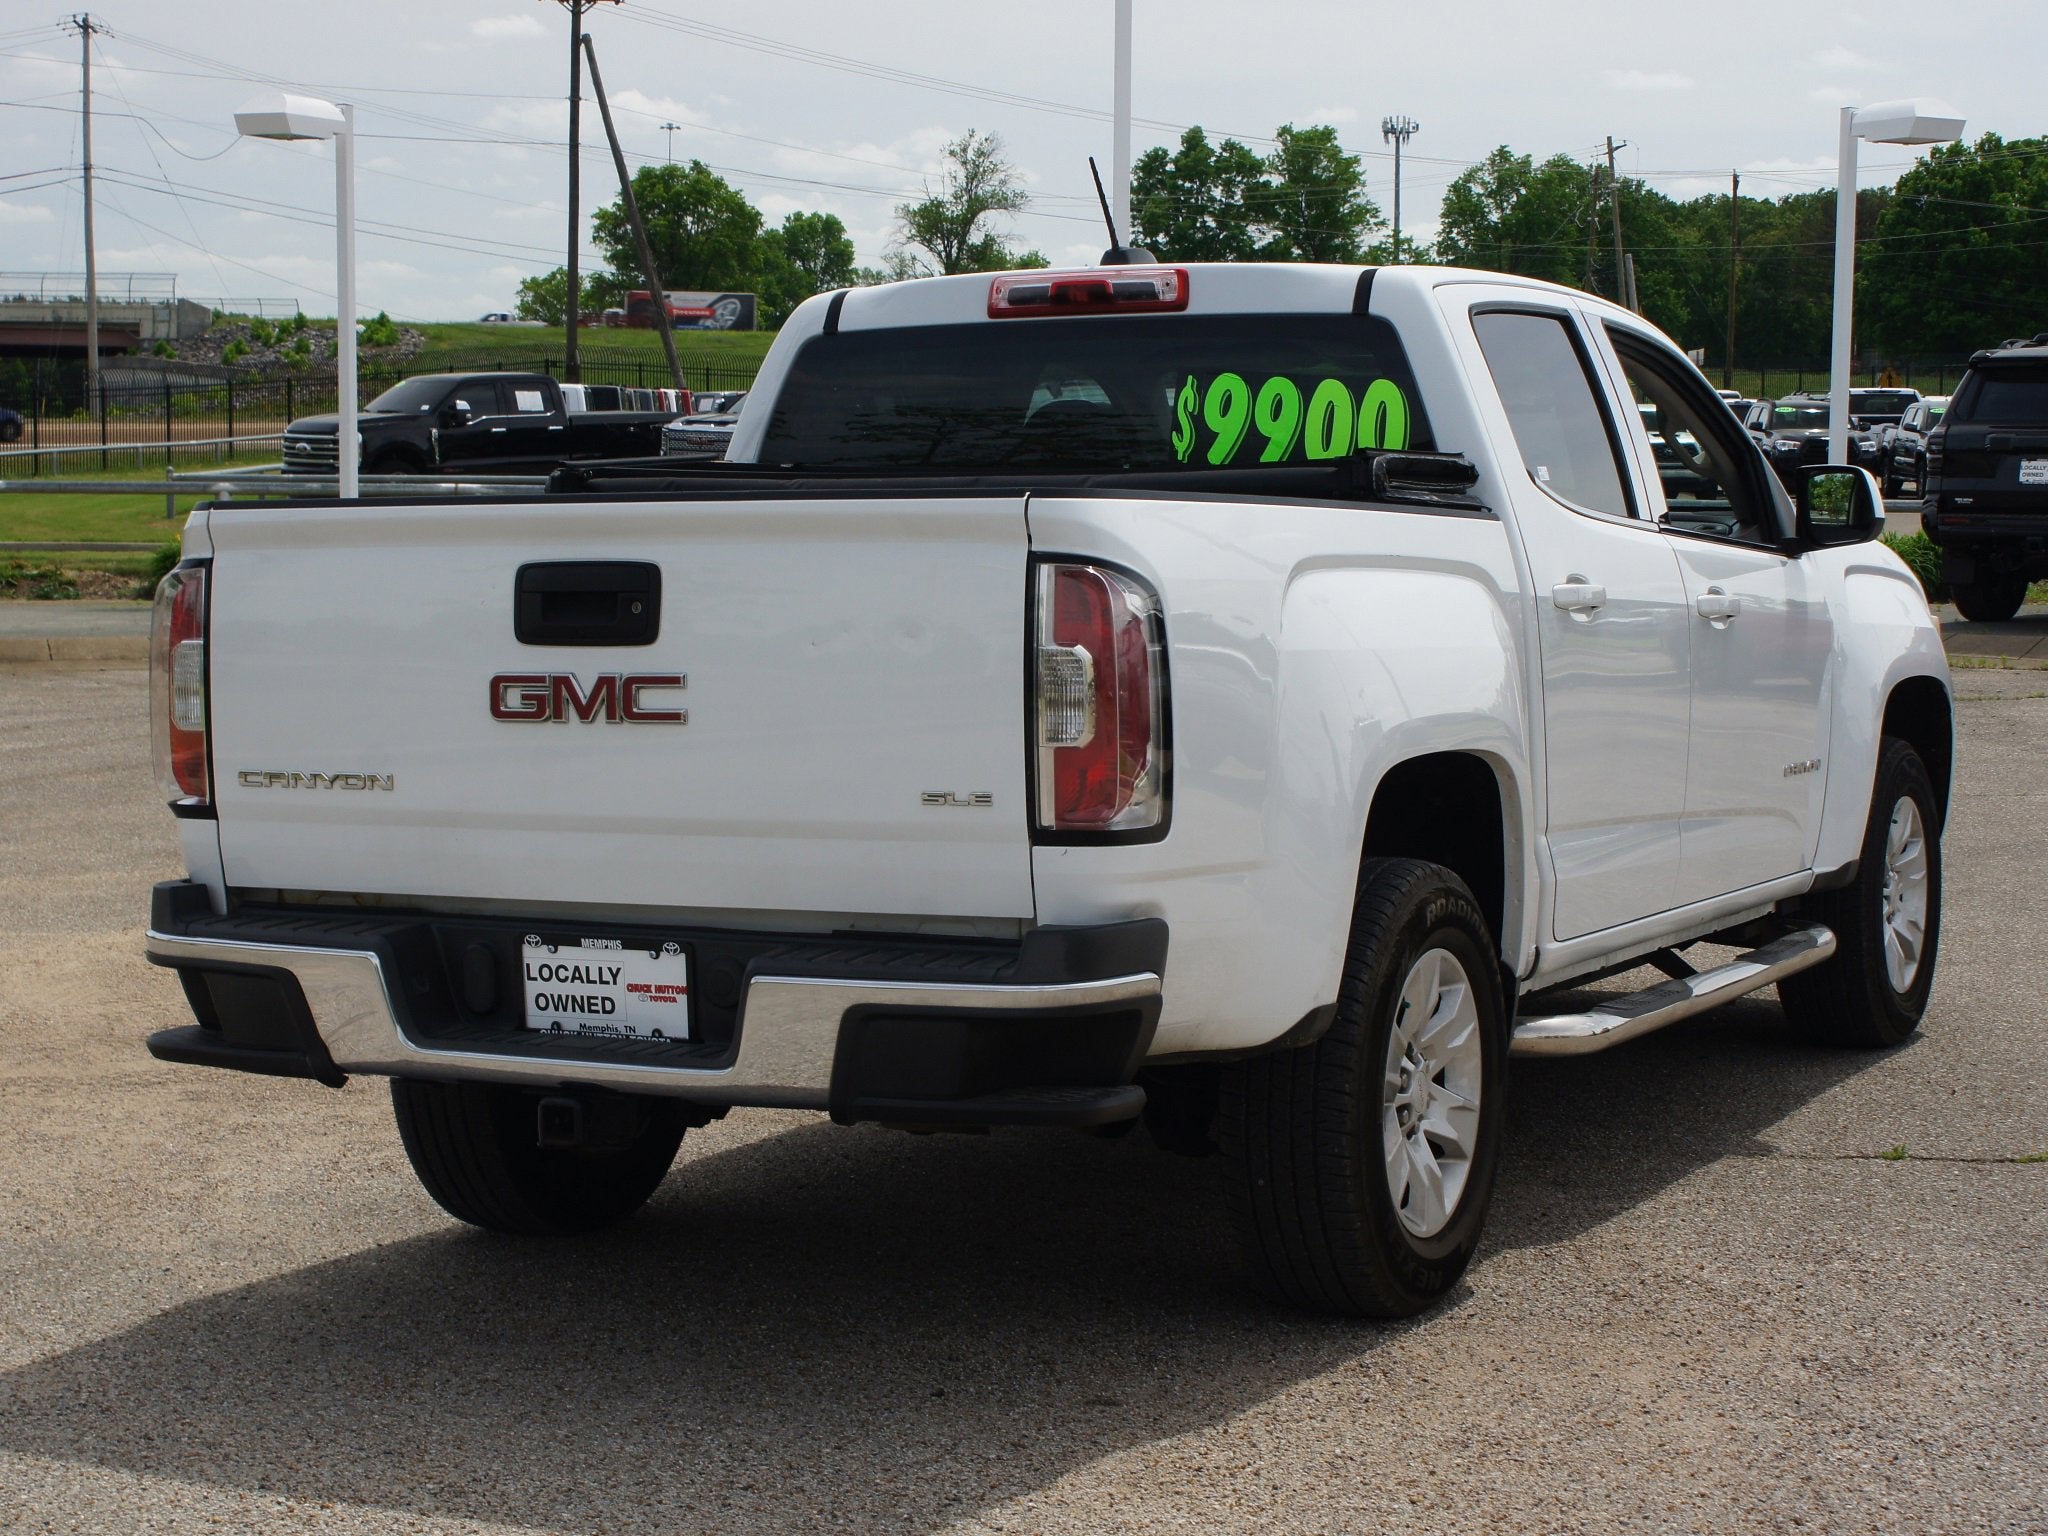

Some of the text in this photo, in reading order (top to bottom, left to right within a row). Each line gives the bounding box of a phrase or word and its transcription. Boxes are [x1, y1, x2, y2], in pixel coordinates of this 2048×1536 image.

[1172, 372, 1411, 465] $9900
[489, 672, 689, 725] GMC
[237, 769, 394, 791] CANYON
[921, 791, 993, 806] SLE
[581, 938, 623, 950] MEMPHIS
[525, 962, 622, 986] LOCALLY
[626, 983, 688, 996] CHUCK HUTTON
[534, 992, 616, 1015] OWNED
[649, 996, 678, 1004] TOYOTA
[579, 1023, 636, 1035] Memphis, TN
